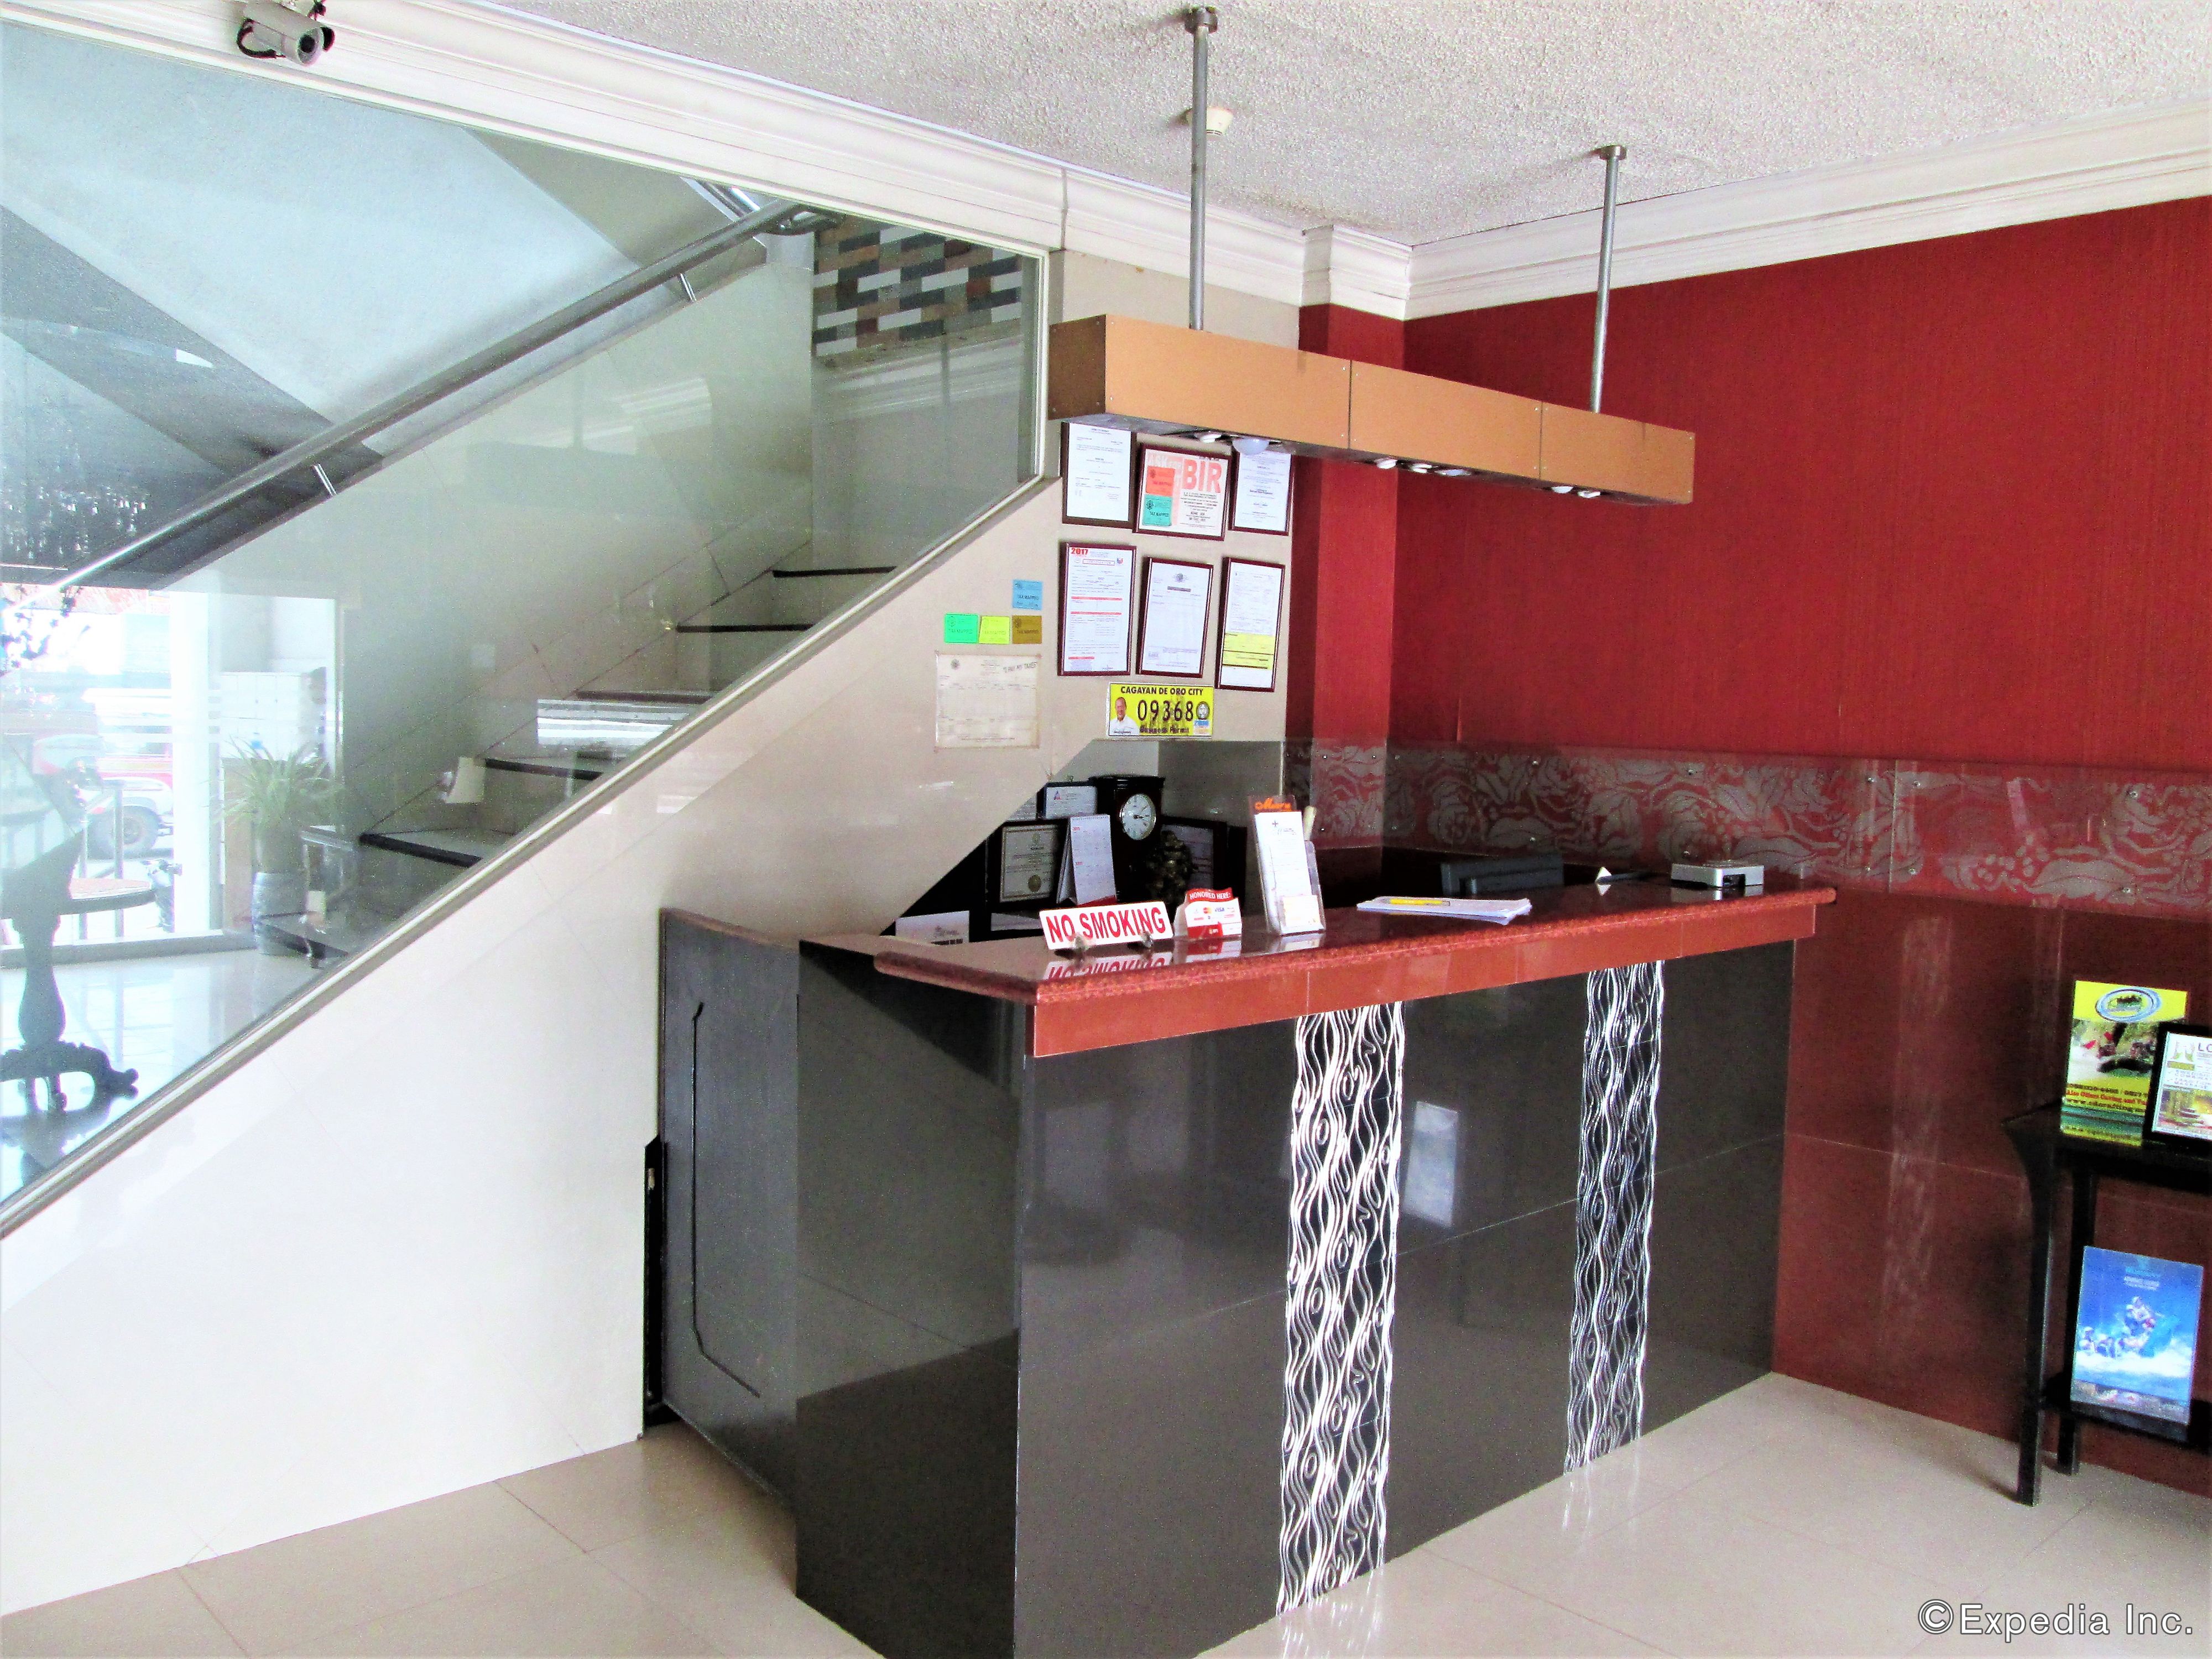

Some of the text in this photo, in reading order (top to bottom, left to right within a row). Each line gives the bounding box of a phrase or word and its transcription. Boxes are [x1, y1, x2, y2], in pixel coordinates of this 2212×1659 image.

[1182, 458, 1222, 493] BIR
[1071, 547, 1089, 555] 2017
[1120, 686, 1157, 695] CAGAYAN
[1159, 687, 1168, 695] DE
[1137, 699, 1194, 722] 09368
[1140, 725, 1168, 733] Business
[1170, 725, 1190, 734] Permit
[1190, 891, 1216, 900] HONORED
[1046, 906, 1166, 943] NO SMOKING
